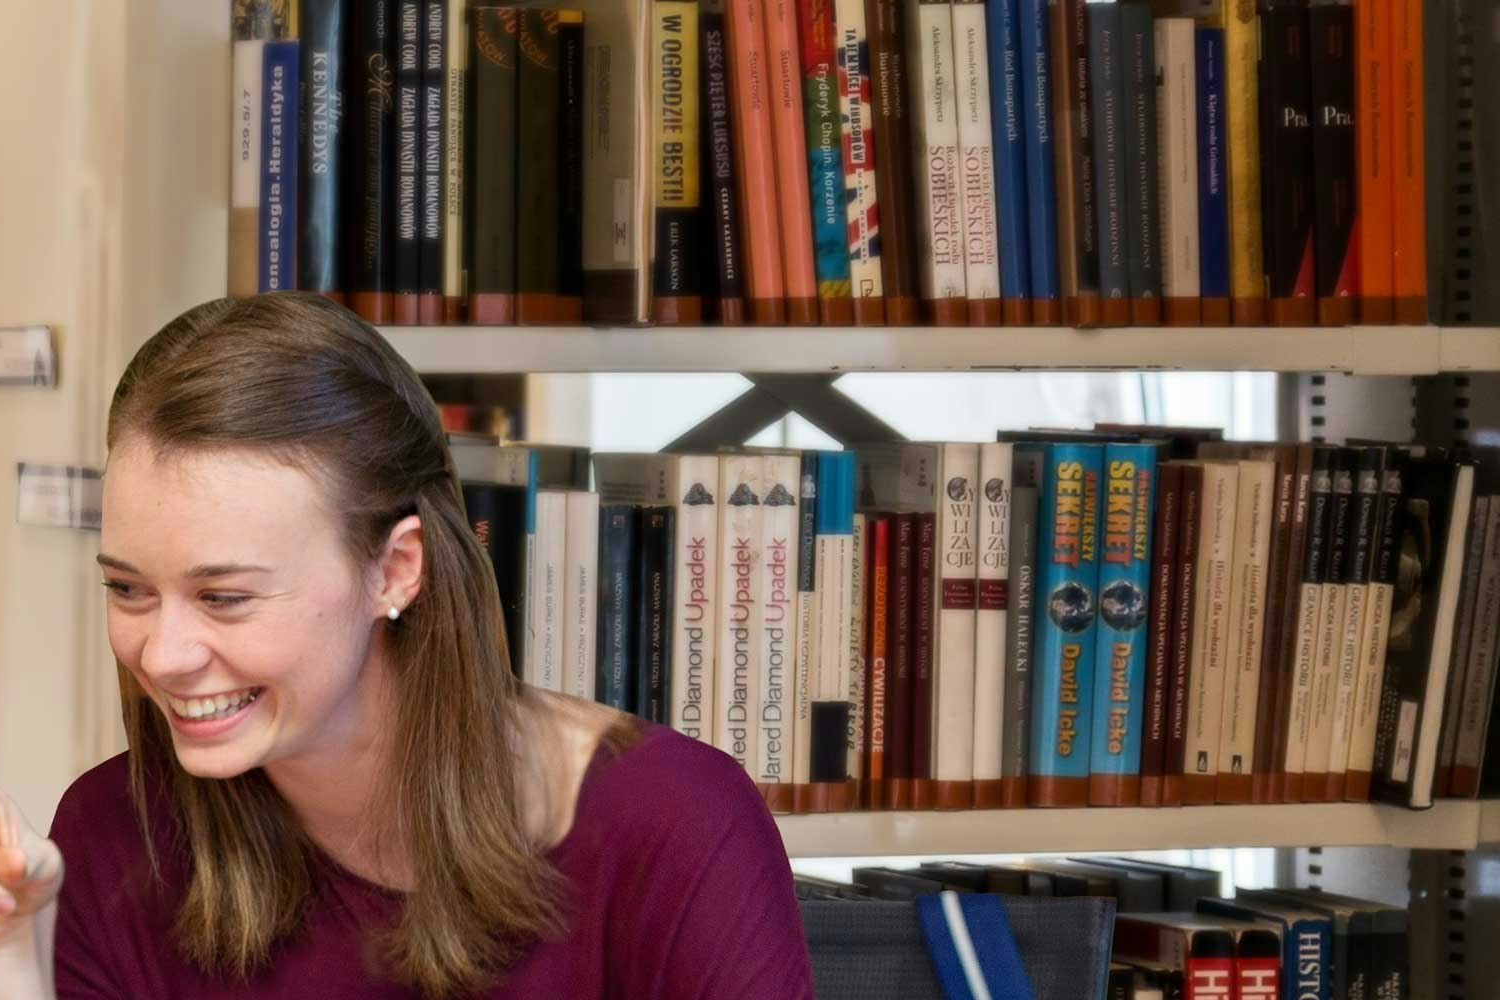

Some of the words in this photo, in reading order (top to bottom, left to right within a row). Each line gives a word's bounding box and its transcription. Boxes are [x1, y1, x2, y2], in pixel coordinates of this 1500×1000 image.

[402, 2, 417, 41] ANDREW
[428, 2, 442, 40] ANDREW
[662, 15, 683, 33] W
[402, 43, 417, 70] COOK
[428, 43, 442, 70] COOK
[779, 49, 793, 110] Stuartowie
[845, 28, 862, 89] TAJEMNICE
[1004, 50, 1016, 72] Ród
[1036, 51, 1047, 74] Ród
[662, 38, 685, 135] OGRODZIE
[708, 72, 726, 120] PIĘTER
[749, 50, 763, 112] Stuartowie
[878, 52, 892, 117] Burbonowie
[311, 50, 329, 176] KENNEDYS
[328, 88, 343, 136] The
[401, 87, 416, 129] ZAGŁADA
[427, 86, 442, 128] ZAGŁADA
[849, 96, 866, 162] WINDSORÓW
[1005, 73, 1018, 142] Bonapartych
[1036, 75, 1049, 144] Bonapartych
[401, 130, 416, 172] DYNASTII
[426, 130, 442, 172] DYNASTII
[712, 121, 731, 179] LUKSUSU
[814, 62, 831, 118] Fryderyk
[825, 171, 838, 226] Korzenie
[945, 146, 958, 190] Rozkwit
[980, 146, 991, 190] Rozkwit
[266, 64, 285, 290] enealogia.Heraldyka
[449, 168, 459, 176] W
[400, 174, 417, 240] ROMANOWÓW
[425, 174, 442, 240] ROMANOWÓW
[449, 181, 459, 216] POLSCE
[720, 187, 731, 221] CEZARY
[930, 146, 950, 266] SOBIESKICH
[946, 197, 958, 238] upadek
[964, 146, 985, 266] SOBIESKICH
[981, 197, 993, 238] upadek
[669, 221, 679, 247] ERIK
[950, 239, 960, 265] rodu
[985, 239, 995, 265] rodu
[670, 248, 681, 290] LARSON
[1281, 474, 1292, 500] Marcin
[1297, 474, 1308, 500] Marcin
[1053, 461, 1083, 568] SEKRET
[1082, 471, 1098, 561] NAJWIĘKSZY
[1105, 460, 1135, 567] SEKRET
[1133, 468, 1150, 560] NAJWIĘKSZY
[946, 551, 973, 568] CJE
[950, 535, 971, 550] ZA
[684, 536, 709, 623] Upadek
[730, 536, 755, 623] Upadek
[765, 536, 791, 623] Upadek
[1017, 564, 1031, 609] OSKAR
[1157, 563, 1170, 631] DOKUMENTACJA
[1179, 563, 1192, 630] DOKUMENTACJA
[1213, 560, 1226, 600] Historia
[1248, 563, 1261, 604] Historia
[1211, 601, 1224, 617] dla
[1247, 605, 1259, 621] dla
[1304, 586, 1318, 637] GRANICE
[1324, 586, 1338, 626] OBLICZA
[1347, 586, 1363, 636] GRANICE
[1371, 586, 1386, 626] OBLICZA
[1016, 614, 1031, 673] HALECKI
[1155, 632, 1167, 677] SPECJALNA
[1177, 631, 1189, 676] SPECJALNA
[1298, 638, 1314, 688] HISTORII
[1322, 626, 1335, 667] HISTORII
[1341, 638, 1357, 687] HISTORII
[1368, 626, 1381, 666] HISTORII
[681, 627, 704, 723] Diamond
[727, 628, 749, 723] Diamond
[762, 627, 784, 723] Diamond
[1059, 643, 1081, 703] David
[1109, 641, 1133, 701] David
[872, 656, 885, 753] CYWILIZACJE
[727, 727, 747, 766] red
[761, 727, 783, 783] Jared
[1057, 708, 1079, 757] Icke
[1108, 707, 1130, 755] Icke
